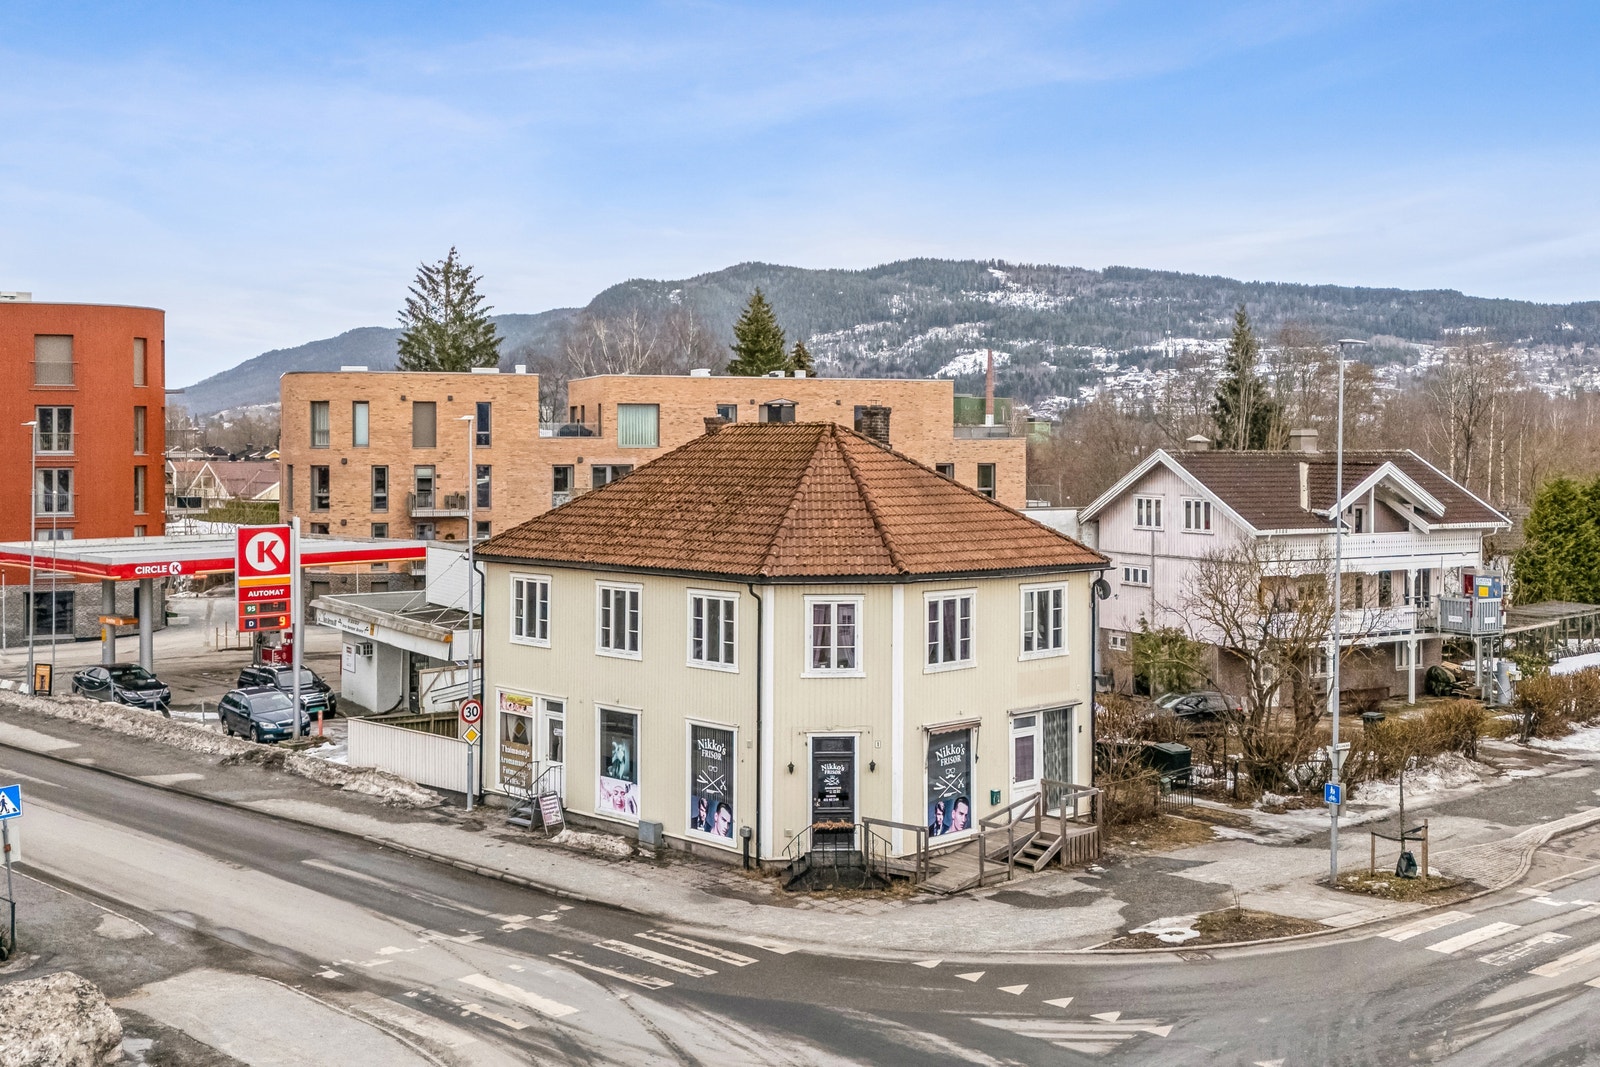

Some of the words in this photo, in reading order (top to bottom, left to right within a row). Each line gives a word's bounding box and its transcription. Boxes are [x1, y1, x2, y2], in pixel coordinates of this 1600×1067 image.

[253, 537, 283, 570] K
[134, 565, 168, 575] CIRCLE
[171, 563, 181, 574] K
[248, 588, 285, 598] AUTOMAT
[246, 605, 256, 613] 95
[465, 705, 479, 718] 30
[697, 738, 727, 756] Nikko's
[935, 743, 966, 762] Nikko's
